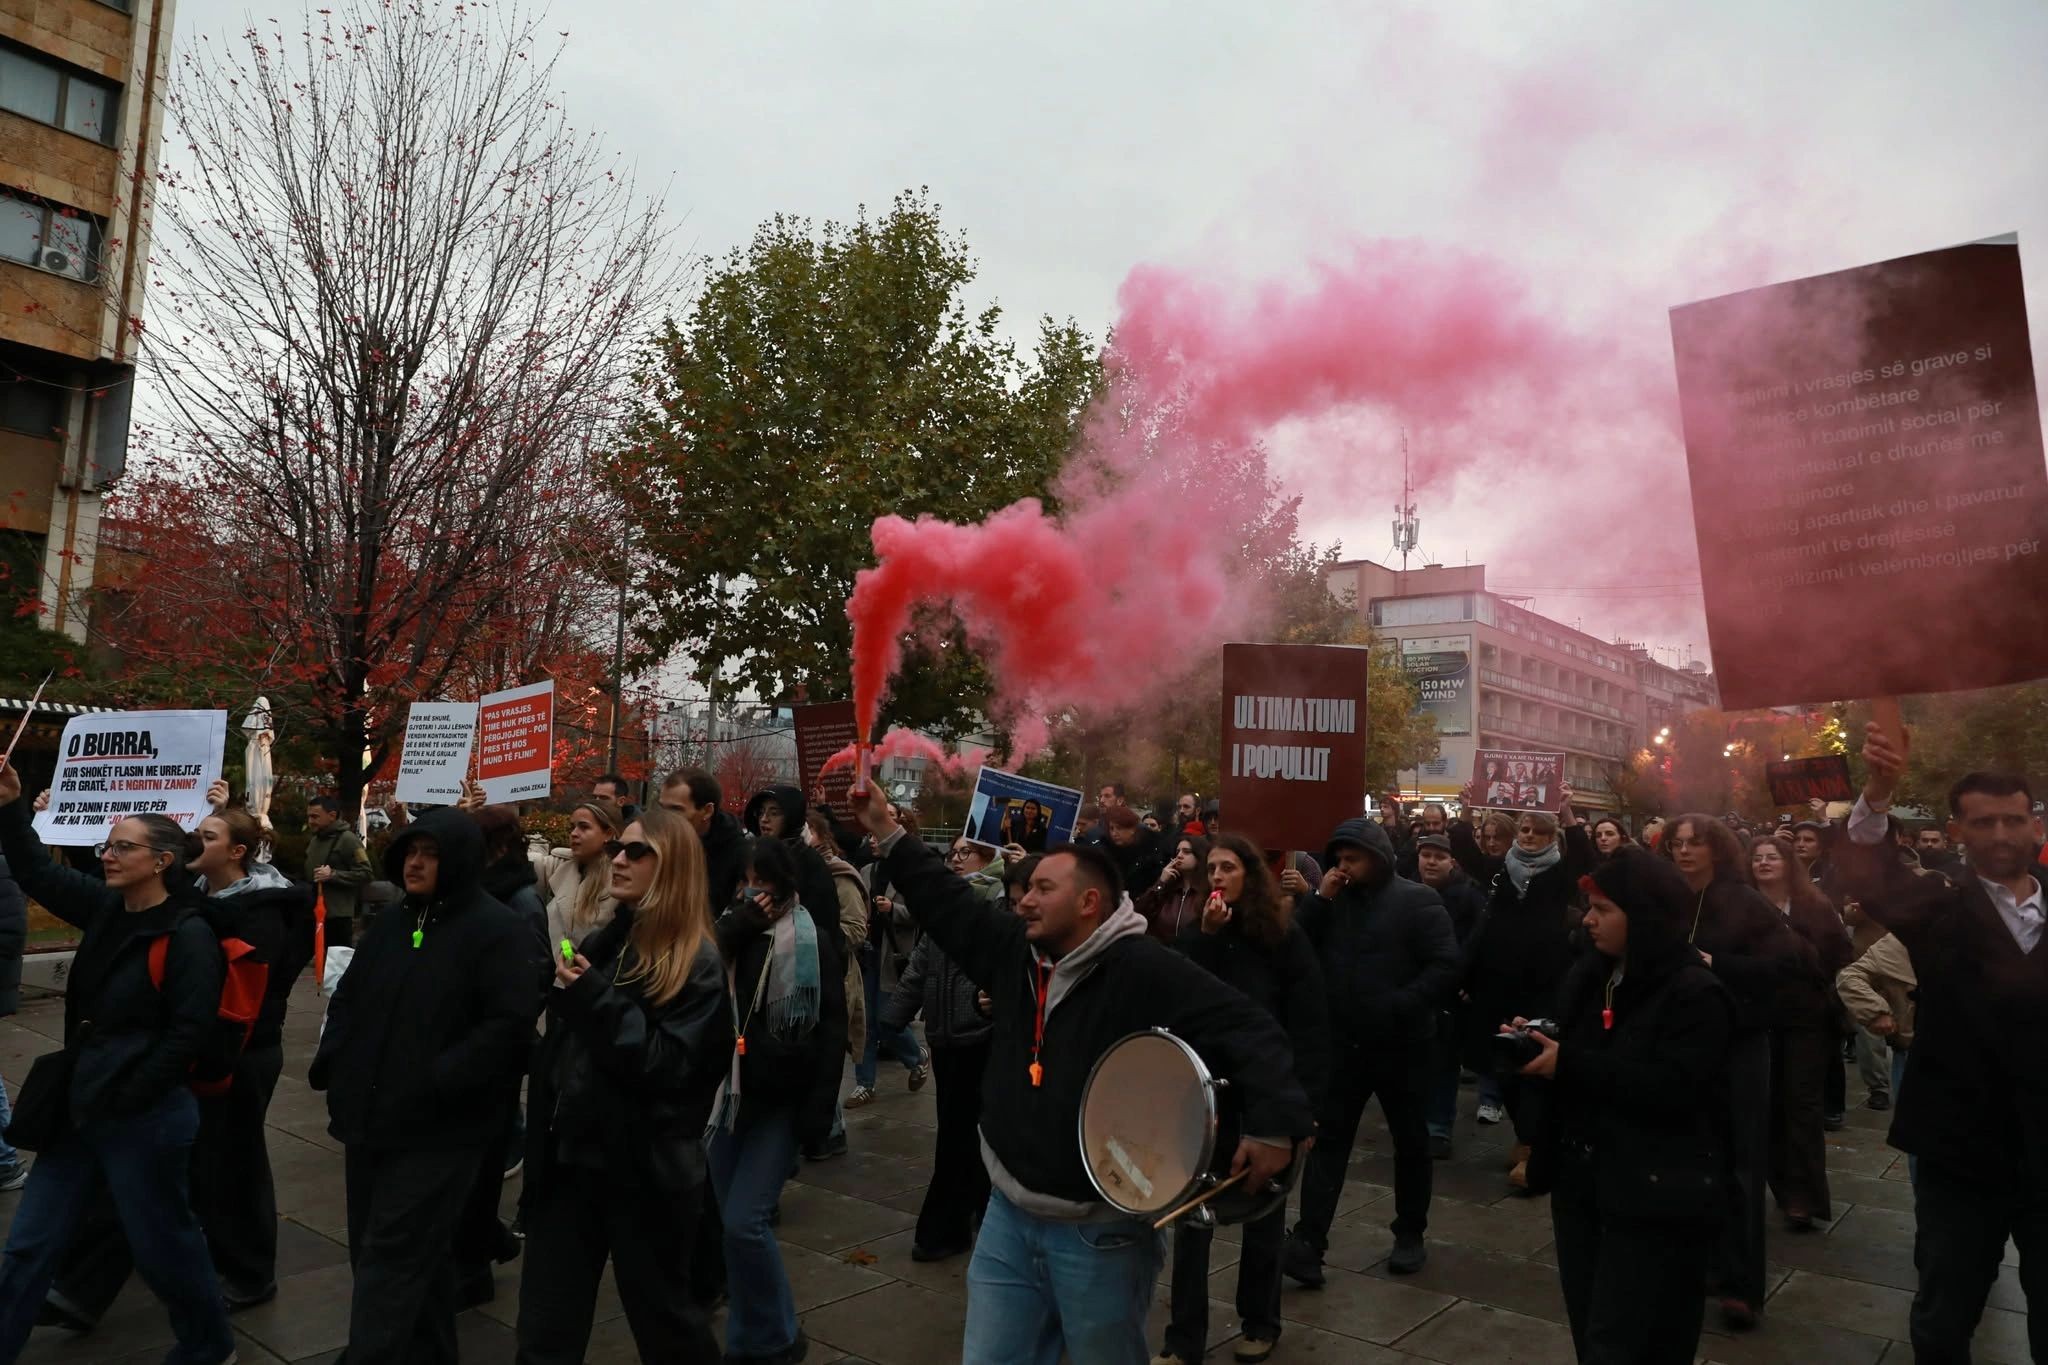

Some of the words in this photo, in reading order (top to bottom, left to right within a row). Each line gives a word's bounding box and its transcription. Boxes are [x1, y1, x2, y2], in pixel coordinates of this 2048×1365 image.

[1803, 369, 1875, 392] vrasjes
[1880, 360, 1904, 378] së
[1911, 351, 1968, 376] grave
[1974, 344, 1992, 360] si
[1814, 388, 1920, 416] kombëtare
[1902, 406, 1960, 430] social
[1968, 400, 2002, 424] për
[1870, 450, 1881, 464] e
[1970, 431, 2004, 448] me
[1890, 498, 1928, 517] dhe
[1946, 485, 2025, 512] pavarur
[2004, 538, 2040, 560] për
[1420, 680, 1438, 690] 150
[1440, 679, 1464, 689] MW
[1422, 690, 1456, 700] WIND
[501, 704, 532, 718] VRASJES
[1234, 696, 1356, 733] ULTIMATUMI
[485, 724, 500, 732] TIME
[502, 720, 516, 728] NUK
[518, 715, 536, 724] PRES
[537, 712, 546, 720] TË
[484, 728, 528, 743] PËRGJIGJENI
[534, 724, 548, 734] POR
[68, 734, 80, 757] O
[82, 731, 158, 759] BURRA,
[484, 745, 500, 754] PRES
[502, 742, 510, 750] TË
[512, 739, 528, 748] MOS
[483, 756, 502, 765] MUND
[504, 752, 512, 762] TË
[1232, 744, 1240, 776] I
[1243, 744, 1330, 781] POPULLIT
[63, 766, 78, 778] KUR
[80, 764, 112, 778] SHOKËT
[114, 765, 144, 776] FLASIN
[146, 765, 158, 776] ME
[160, 764, 202, 776] URREJTJE
[60, 778, 76, 792] PËR
[78, 778, 108, 792] GRATË,
[110, 780, 116, 791] A
[118, 780, 124, 790] E
[126, 779, 162, 790] NGRITNI
[164, 778, 197, 790] ZANIN?
[510, 785, 530, 794] ARLINDA
[58, 802, 76, 812] APO
[77, 802, 102, 812] ZANIN
[104, 802, 110, 812] E
[110, 802, 131, 812] RUNI
[133, 801, 150, 813] VEÇ
[150, 799, 168, 812] PËR
[52, 816, 66, 824] ME
[67, 815, 80, 825] NA
[82, 815, 105, 825] THON
